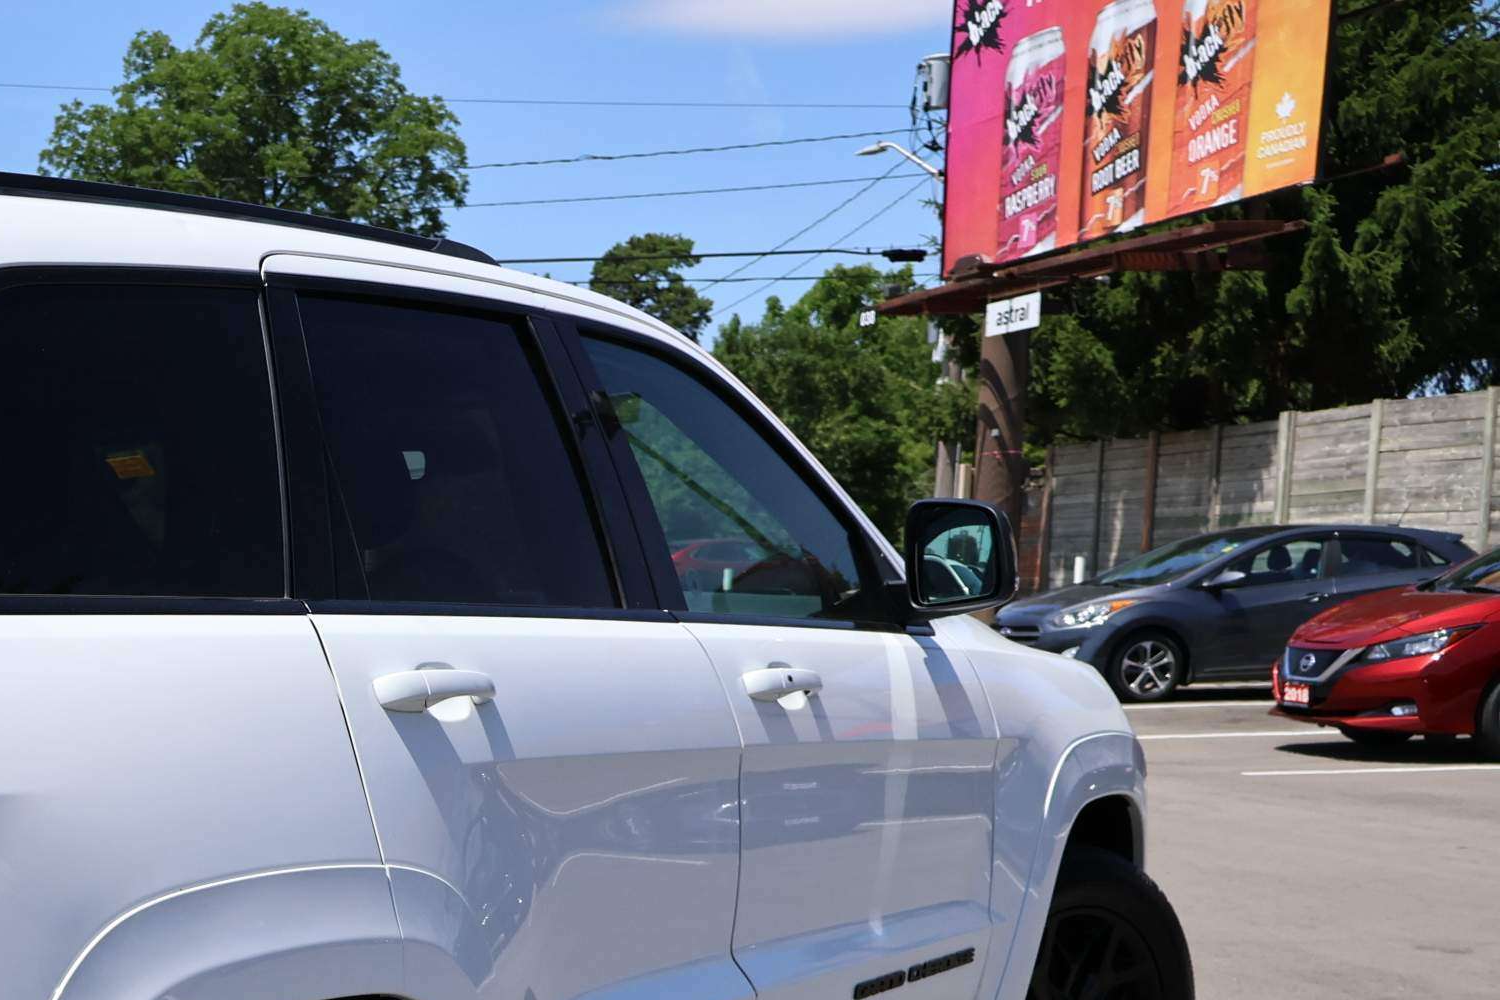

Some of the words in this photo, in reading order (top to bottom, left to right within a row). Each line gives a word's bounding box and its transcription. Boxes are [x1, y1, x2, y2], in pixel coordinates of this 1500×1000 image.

[1188, 94, 1220, 131] VODKA
[1092, 127, 1121, 162] VODKA
[1188, 119, 1238, 163] ORANGE
[1012, 154, 1036, 186] VODKA
[1092, 162, 1114, 193] ROOT
[1114, 148, 1140, 179] BEER
[1005, 173, 1056, 219] RASPBERRY
[996, 302, 1030, 327] astral
[1284, 686, 1310, 703] 2018
